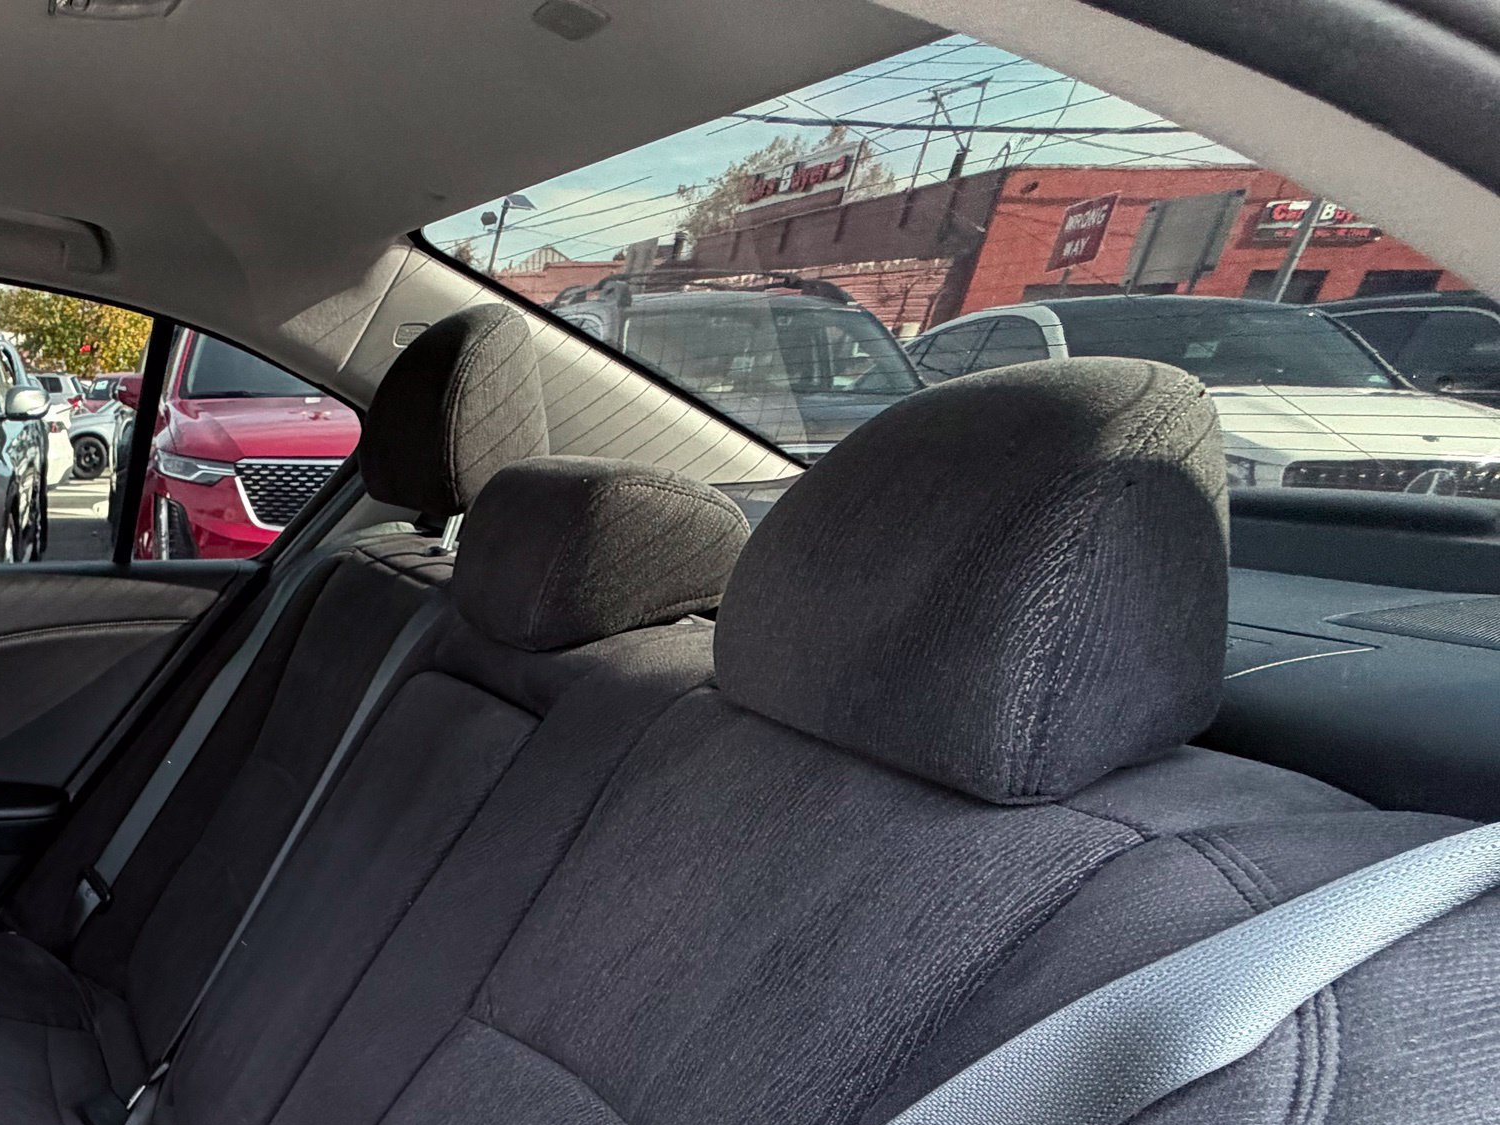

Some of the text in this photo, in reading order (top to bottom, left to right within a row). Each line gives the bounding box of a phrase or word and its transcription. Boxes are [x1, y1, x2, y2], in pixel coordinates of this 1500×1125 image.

[1065, 204, 1109, 231] WRONG
[1320, 203, 1358, 224] Buy
[1063, 236, 1090, 257] WAY
